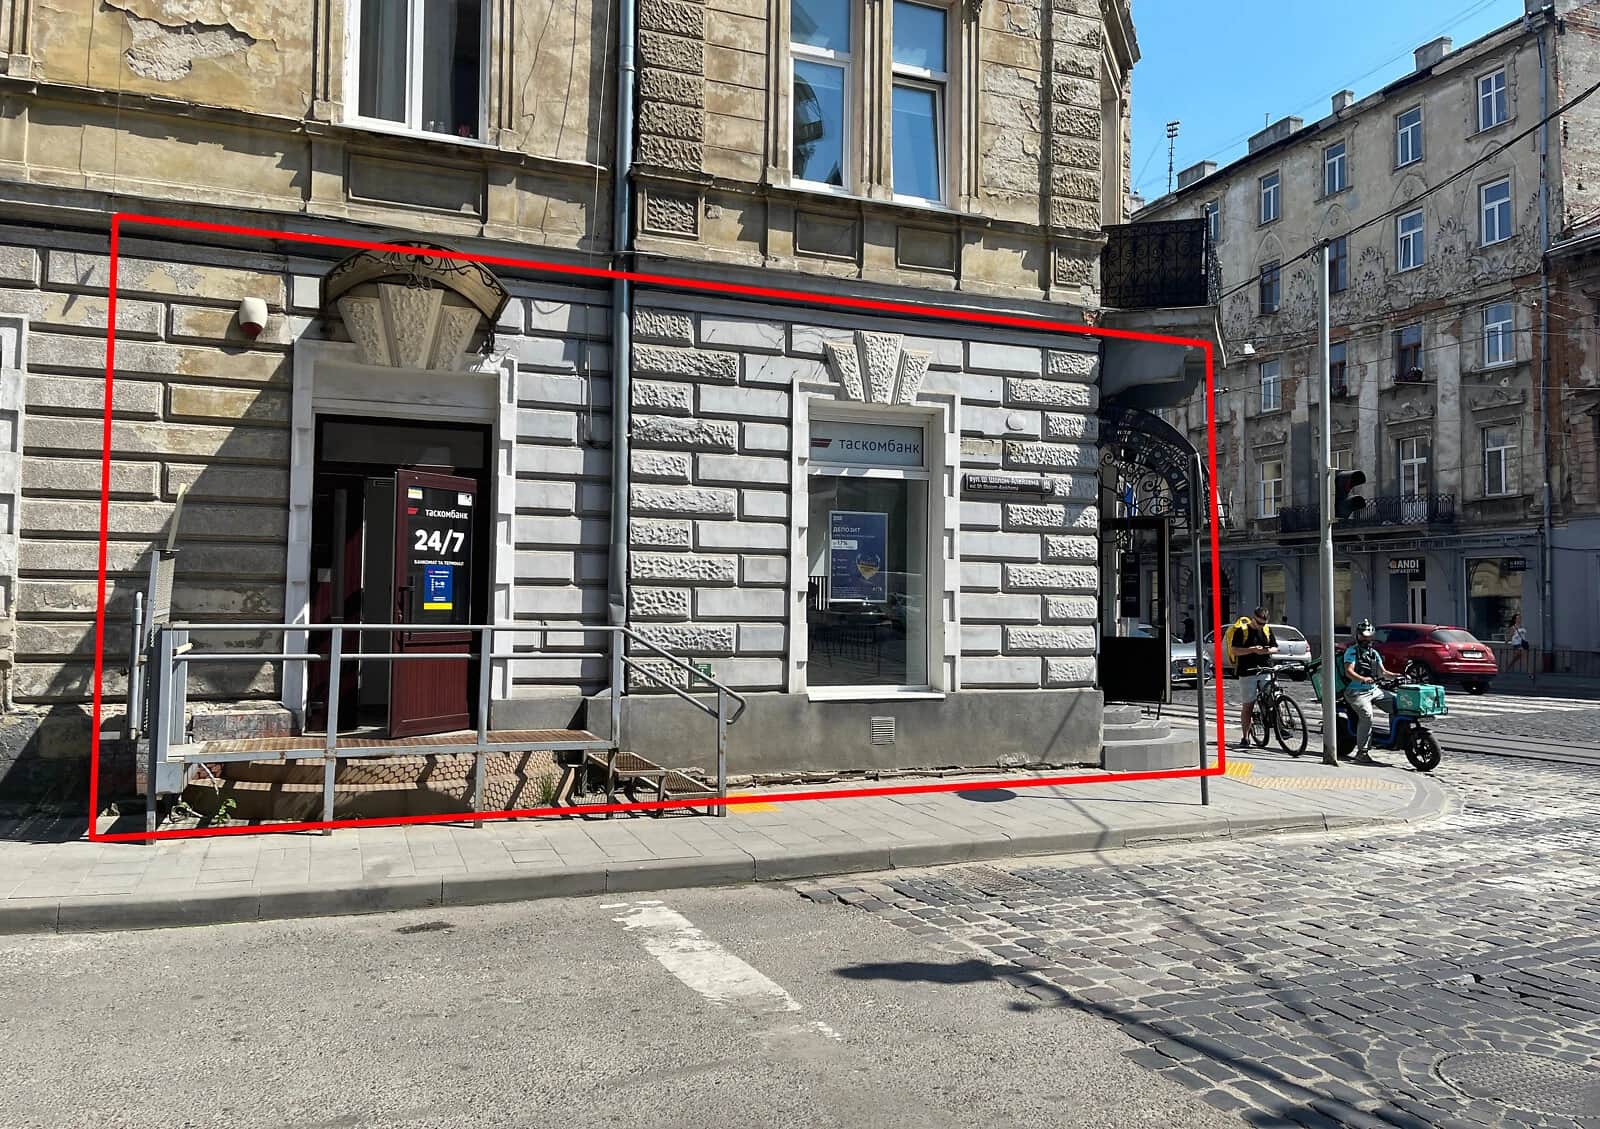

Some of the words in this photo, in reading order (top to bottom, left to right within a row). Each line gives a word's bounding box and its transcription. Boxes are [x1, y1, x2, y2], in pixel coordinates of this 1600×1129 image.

[838, 439, 920, 454] таскомбанк
[425, 509, 468, 520] таскомбанк
[414, 529, 465, 555] 24/7
